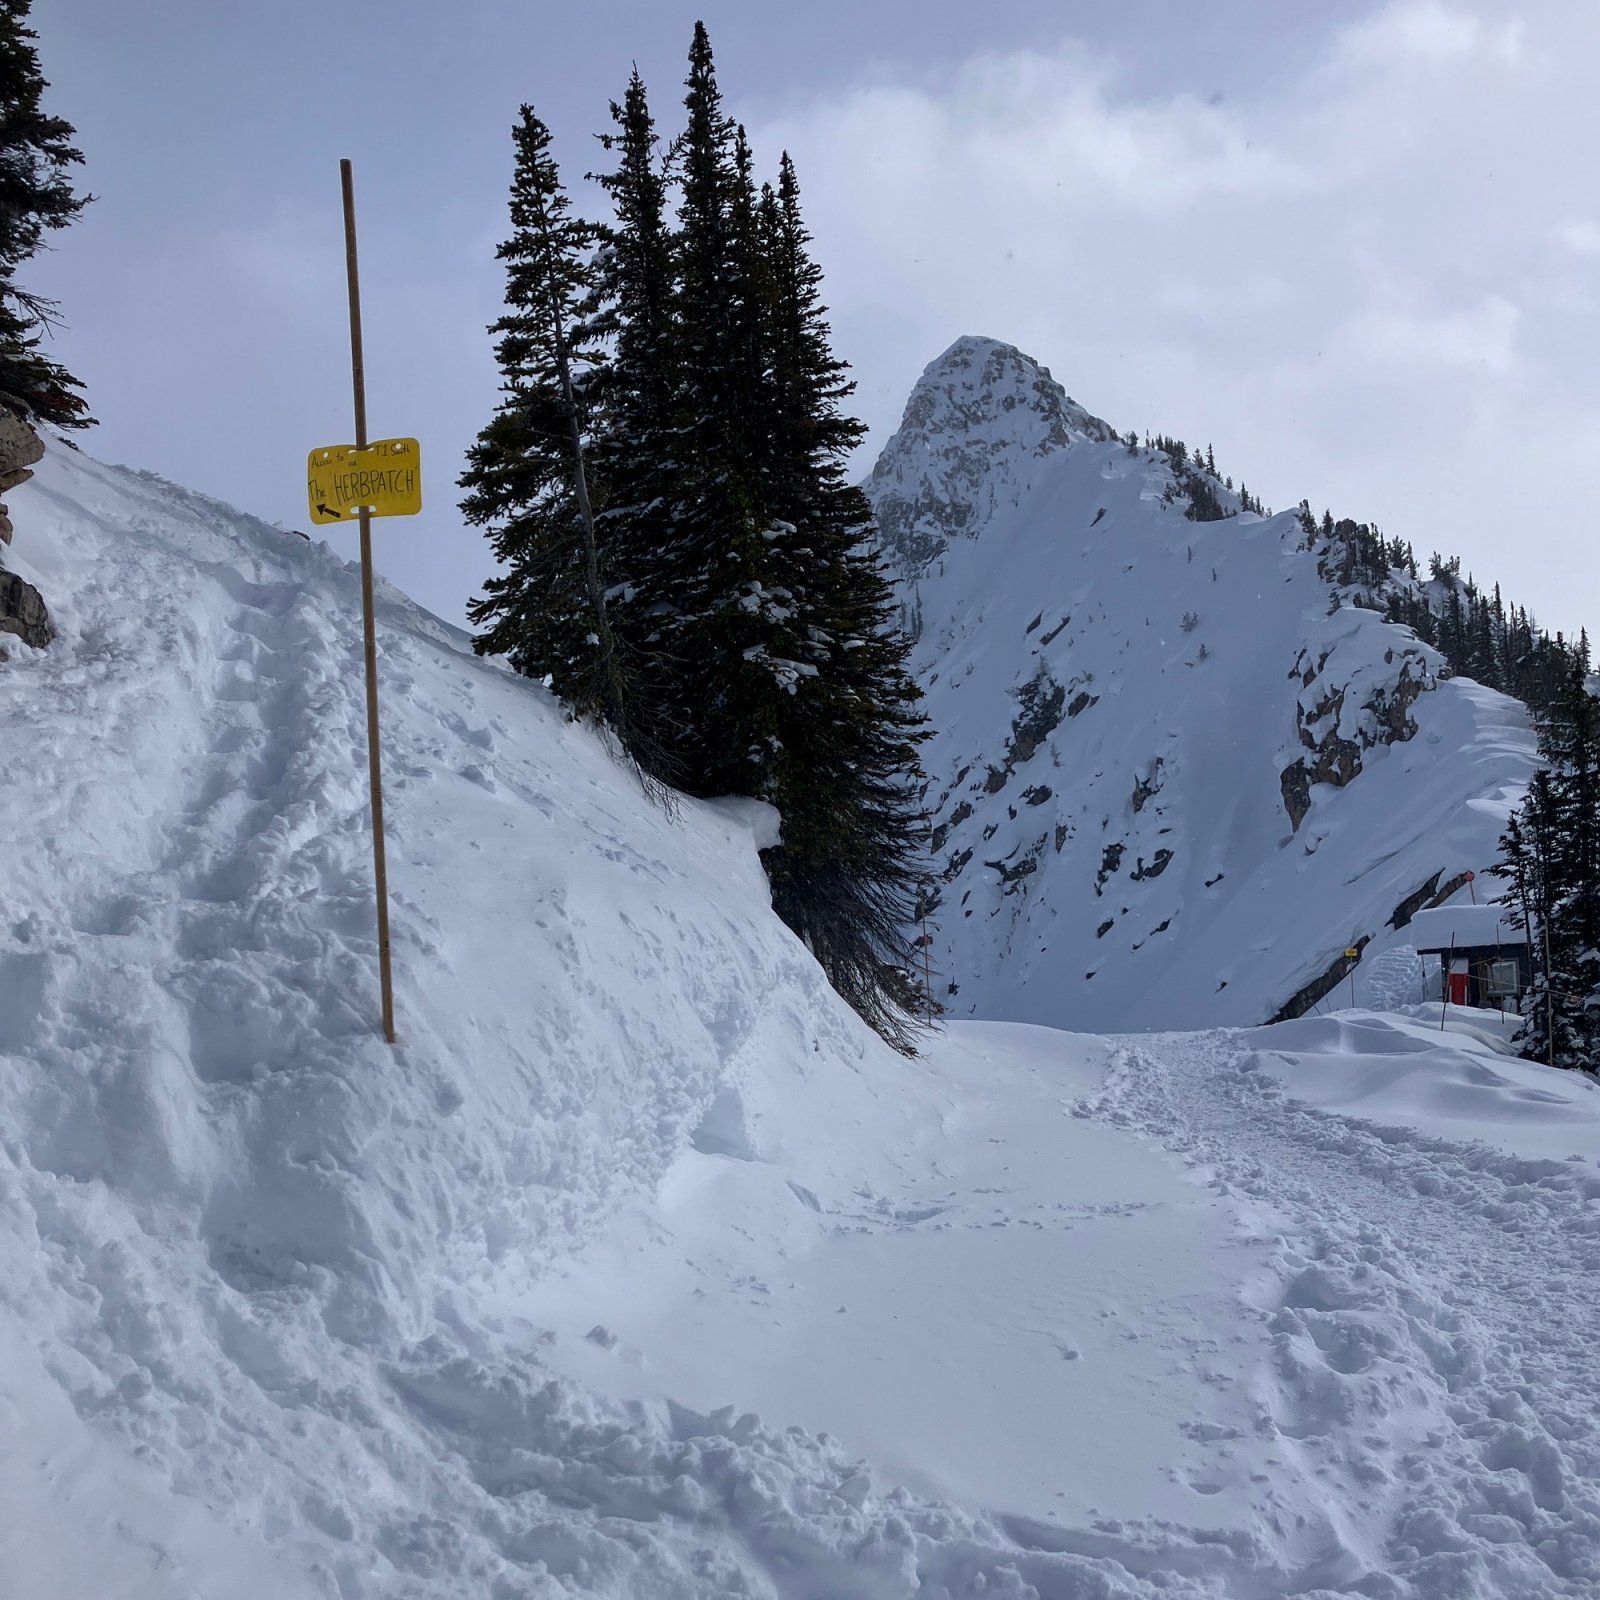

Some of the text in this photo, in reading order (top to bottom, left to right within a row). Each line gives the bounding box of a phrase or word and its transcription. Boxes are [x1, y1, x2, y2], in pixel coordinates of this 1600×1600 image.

[312, 454, 332, 468] Access
[376, 444, 388, 457] T1
[391, 443, 411, 456] South
[308, 479, 326, 501] The
